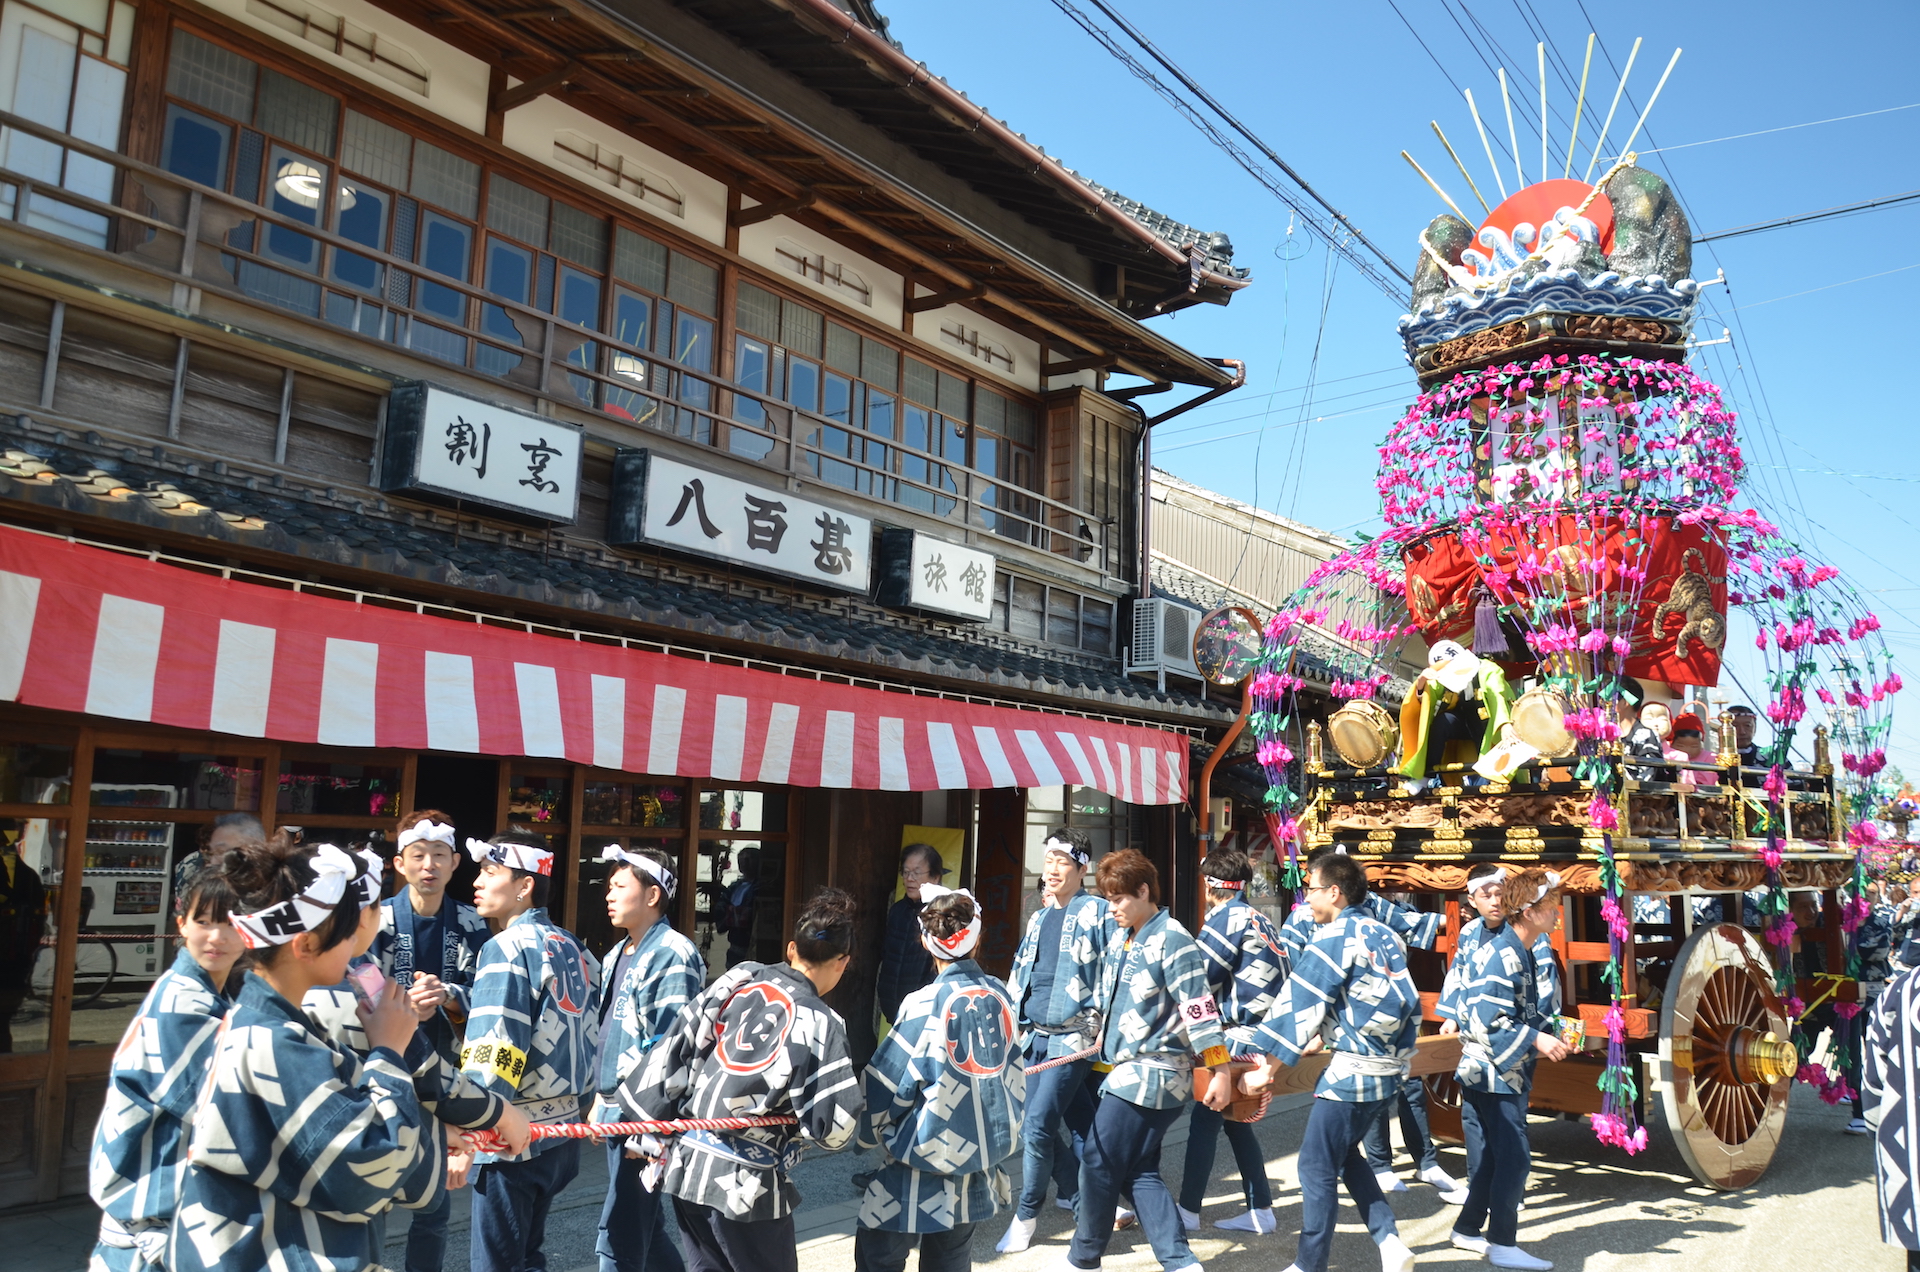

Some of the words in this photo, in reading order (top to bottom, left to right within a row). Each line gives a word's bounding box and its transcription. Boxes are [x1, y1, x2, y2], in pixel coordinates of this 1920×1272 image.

[444, 414, 563, 495] 割烹
[665, 477, 854, 576] 八百甚
[922, 552, 986, 605] 旅館
[946, 993, 1008, 1070] 旭
